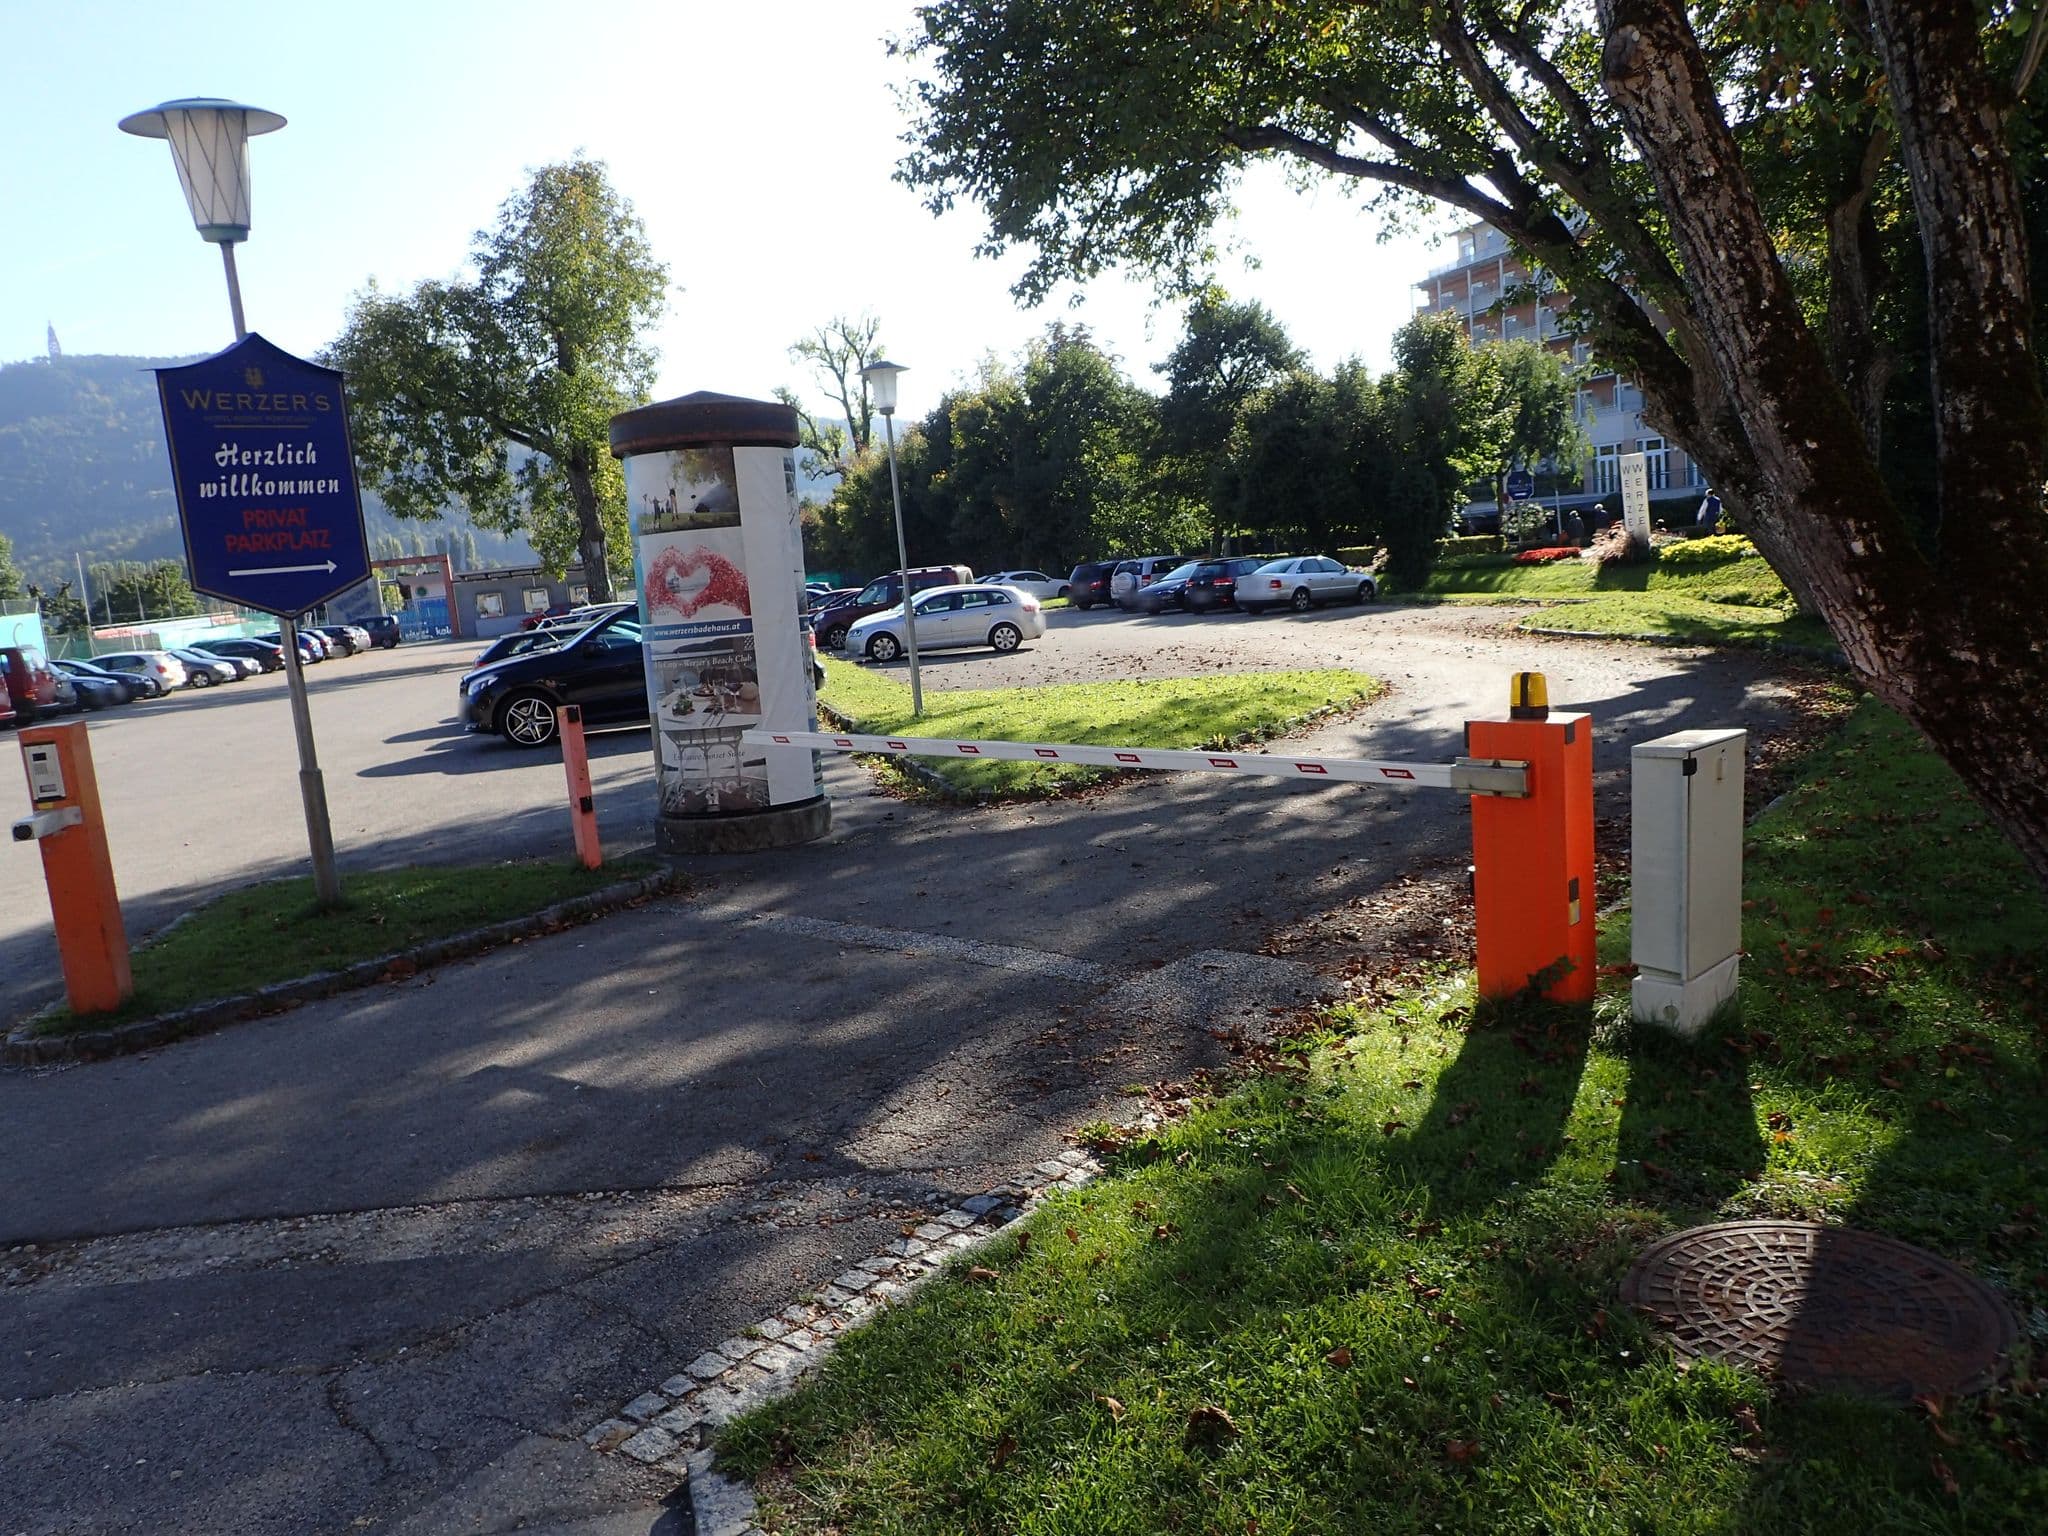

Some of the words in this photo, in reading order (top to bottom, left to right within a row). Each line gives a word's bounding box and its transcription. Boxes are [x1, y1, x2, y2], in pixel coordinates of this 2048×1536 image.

[180, 389, 331, 411] WERZER'S
[214, 442, 317, 467] Herzlich
[200, 473, 340, 498] willkommen
[1622, 464, 1634, 534] WERZE
[242, 508, 308, 529] PRIVAT
[225, 529, 332, 552] PARKPLATZ
